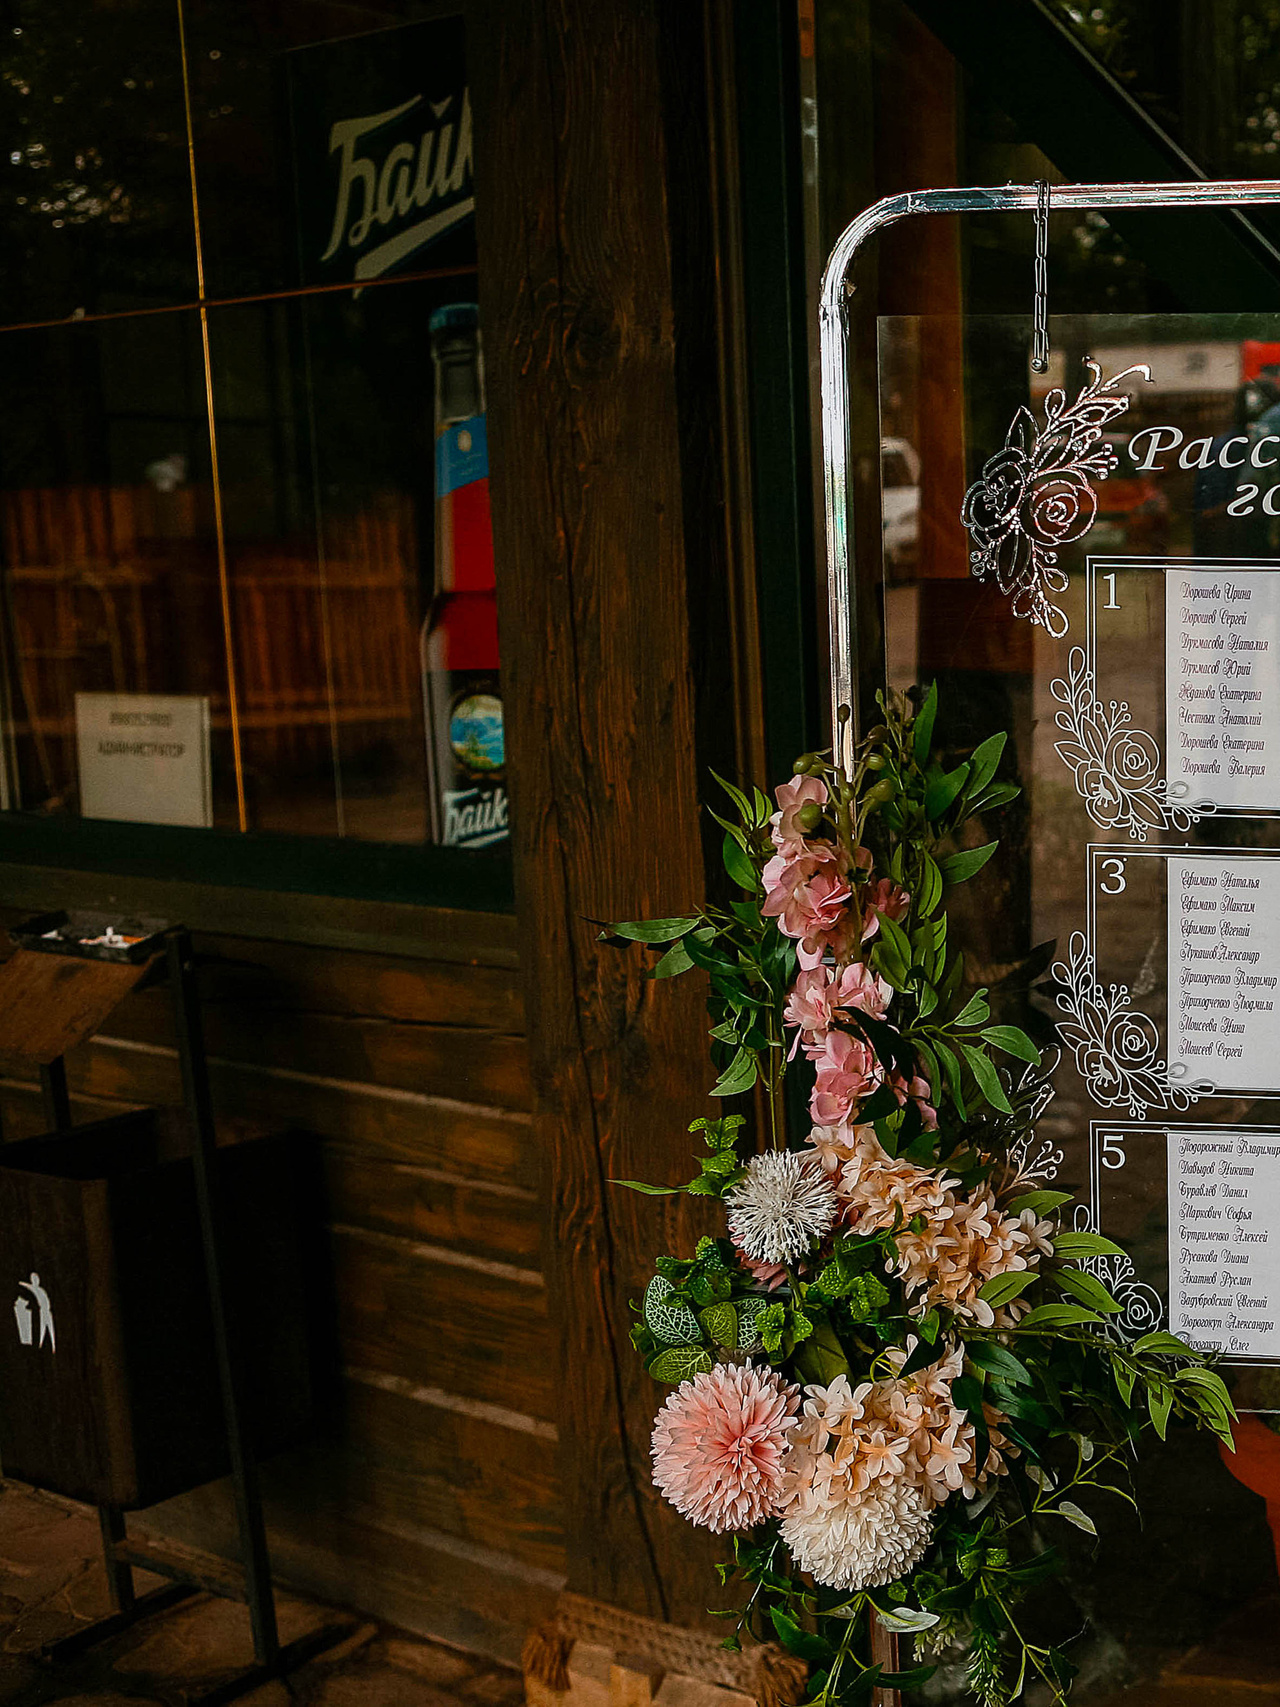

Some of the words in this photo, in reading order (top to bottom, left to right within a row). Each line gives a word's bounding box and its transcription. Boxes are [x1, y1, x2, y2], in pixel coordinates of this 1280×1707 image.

[1103, 573, 1121, 609] 1
[1180, 582, 1221, 601] Дорошева
[1180, 607, 1217, 626] Дорошев
[1220, 608, 1247, 628] Сергей
[1223, 658, 1251, 678] Юрий
[1179, 681, 1215, 701] Жданова
[1219, 683, 1261, 703] Екатерина
[1179, 732, 1218, 751] Дорошева
[1222, 732, 1264, 753] Екатерина
[1181, 757, 1220, 776] Дорошева
[1100, 858, 1126, 894] 3
[1220, 870, 1260, 891] Наталья
[1220, 894, 1255, 914] Максим
[1219, 919, 1250, 940] Евгений
[1217, 941, 1260, 964] Александр
[1234, 967, 1277, 989] Владимир
[1233, 991, 1273, 1012] Людмила
[1179, 1013, 1217, 1033] Моисеева
[1220, 1016, 1245, 1036] Нина
[1178, 1037, 1213, 1057] Моисеев
[1216, 1041, 1243, 1059] Сергей
[1101, 1134, 1126, 1170] 5
[1237, 1136, 1280, 1158] Владимир
[1179, 1160, 1215, 1177] Давыдов
[1219, 1160, 1254, 1178] Никита
[1219, 1183, 1248, 1198] Данил
[1179, 1202, 1221, 1221] Маркович
[1225, 1205, 1252, 1222] Софья
[1232, 1225, 1268, 1244] Алексей
[1221, 1249, 1249, 1263] Диана
[1220, 1271, 1251, 1288] Руслан
[1236, 1292, 1267, 1311] Евгений
[1225, 1312, 1274, 1333] Александра
[1229, 1336, 1249, 1351] Олег
